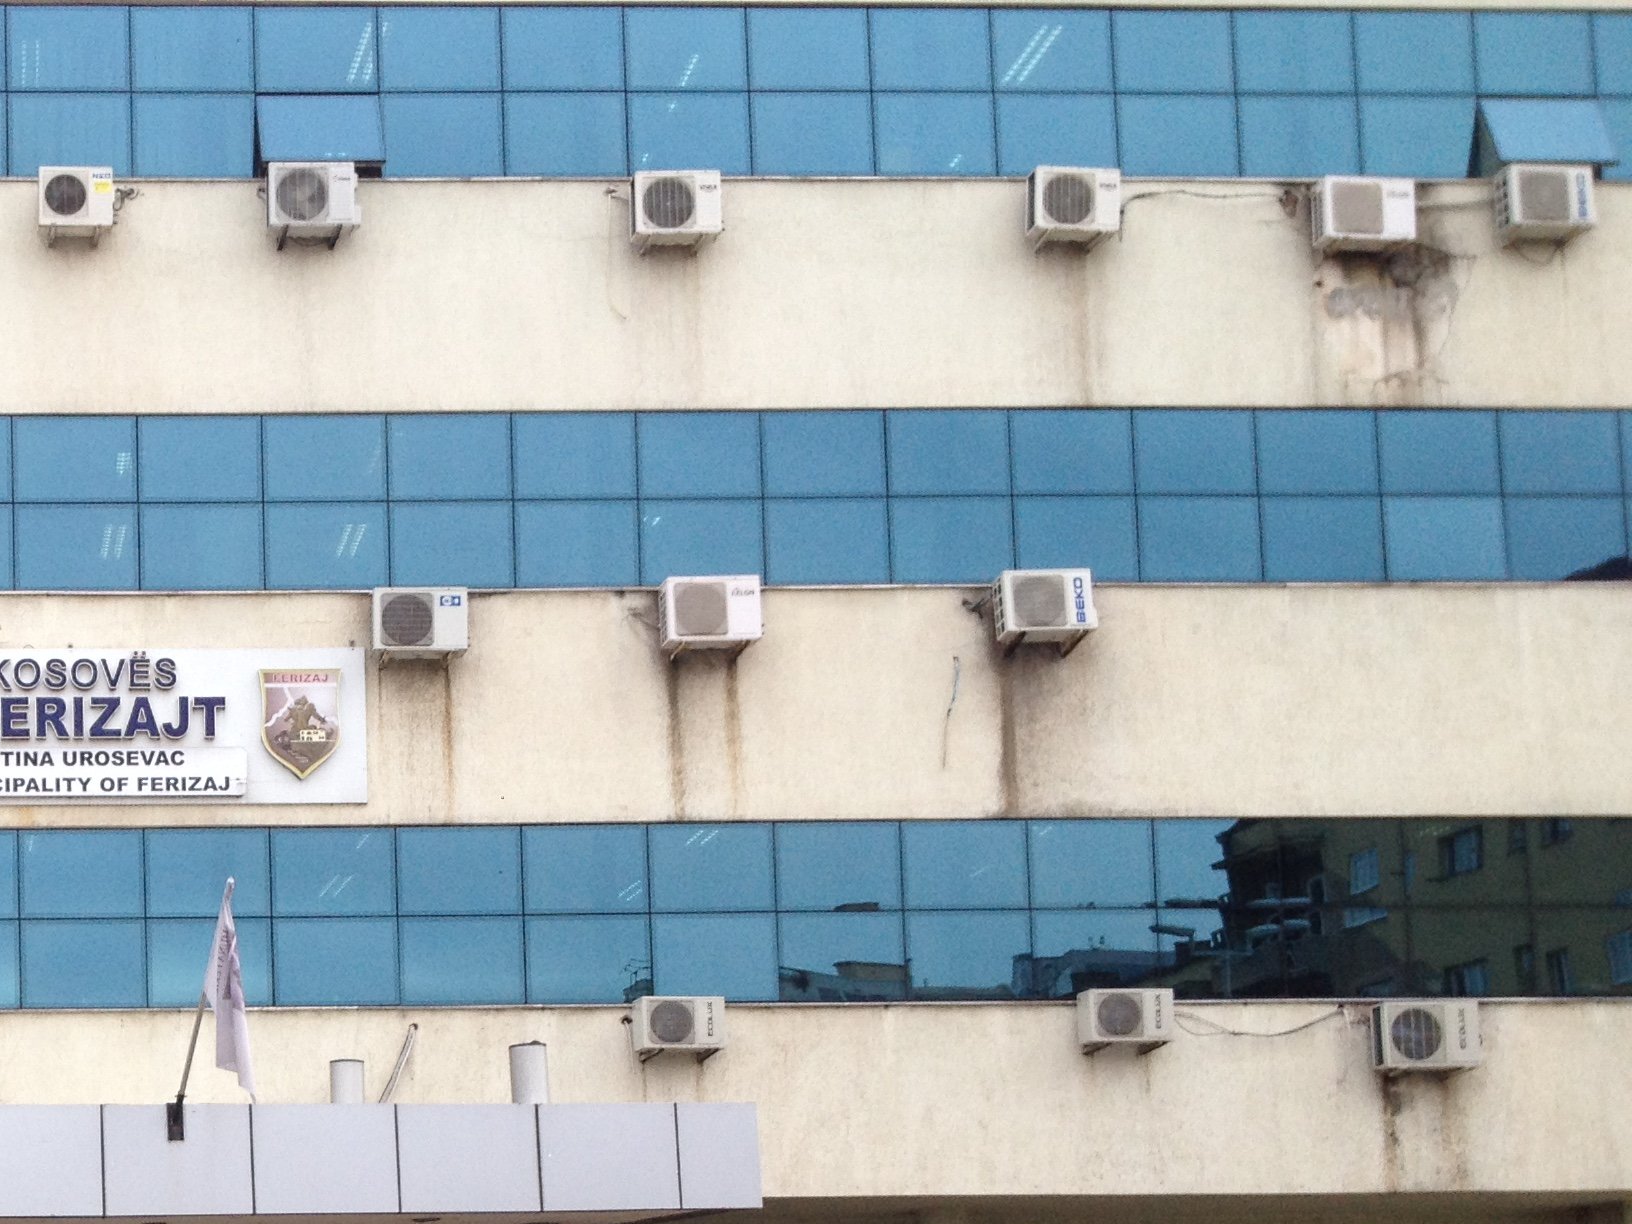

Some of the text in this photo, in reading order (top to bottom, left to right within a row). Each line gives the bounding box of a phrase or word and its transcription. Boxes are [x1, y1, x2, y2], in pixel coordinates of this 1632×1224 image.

[1073, 577, 1086, 623] BEKO
[273, 673, 329, 683] FERIZAJ
[62, 750, 185, 767] UROSEVAC
[100, 777, 129, 792] OF
[137, 776, 231, 792] FERIZAJ
